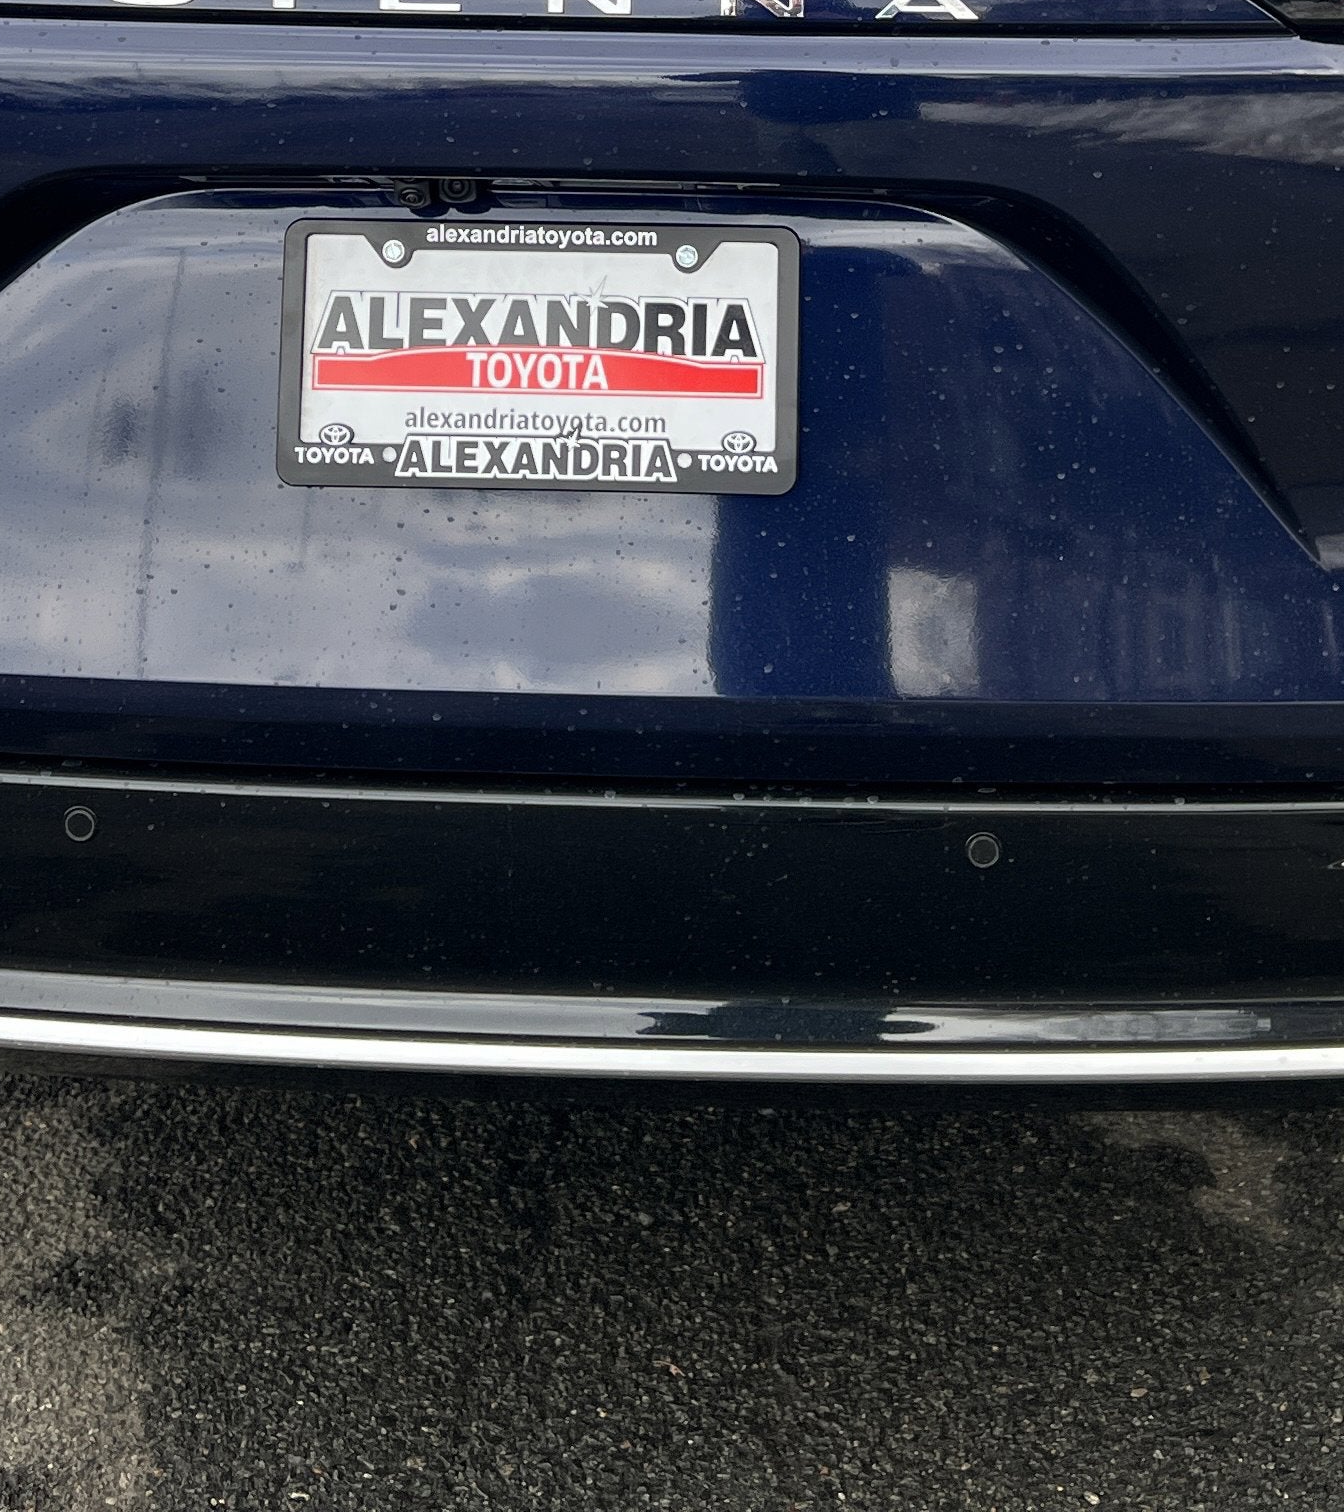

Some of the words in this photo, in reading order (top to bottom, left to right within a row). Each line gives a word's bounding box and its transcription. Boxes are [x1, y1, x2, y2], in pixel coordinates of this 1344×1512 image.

[426, 224, 657, 249] alexandriatoyota.com
[315, 294, 759, 359] ALEXANDRIA
[465, 351, 609, 391] TOYOTA
[404, 406, 666, 438] alexandriatoyota.com
[294, 446, 375, 465] TOYOTA
[396, 437, 676, 482] ALEXANDRIA
[697, 454, 778, 474] TOYOTA
